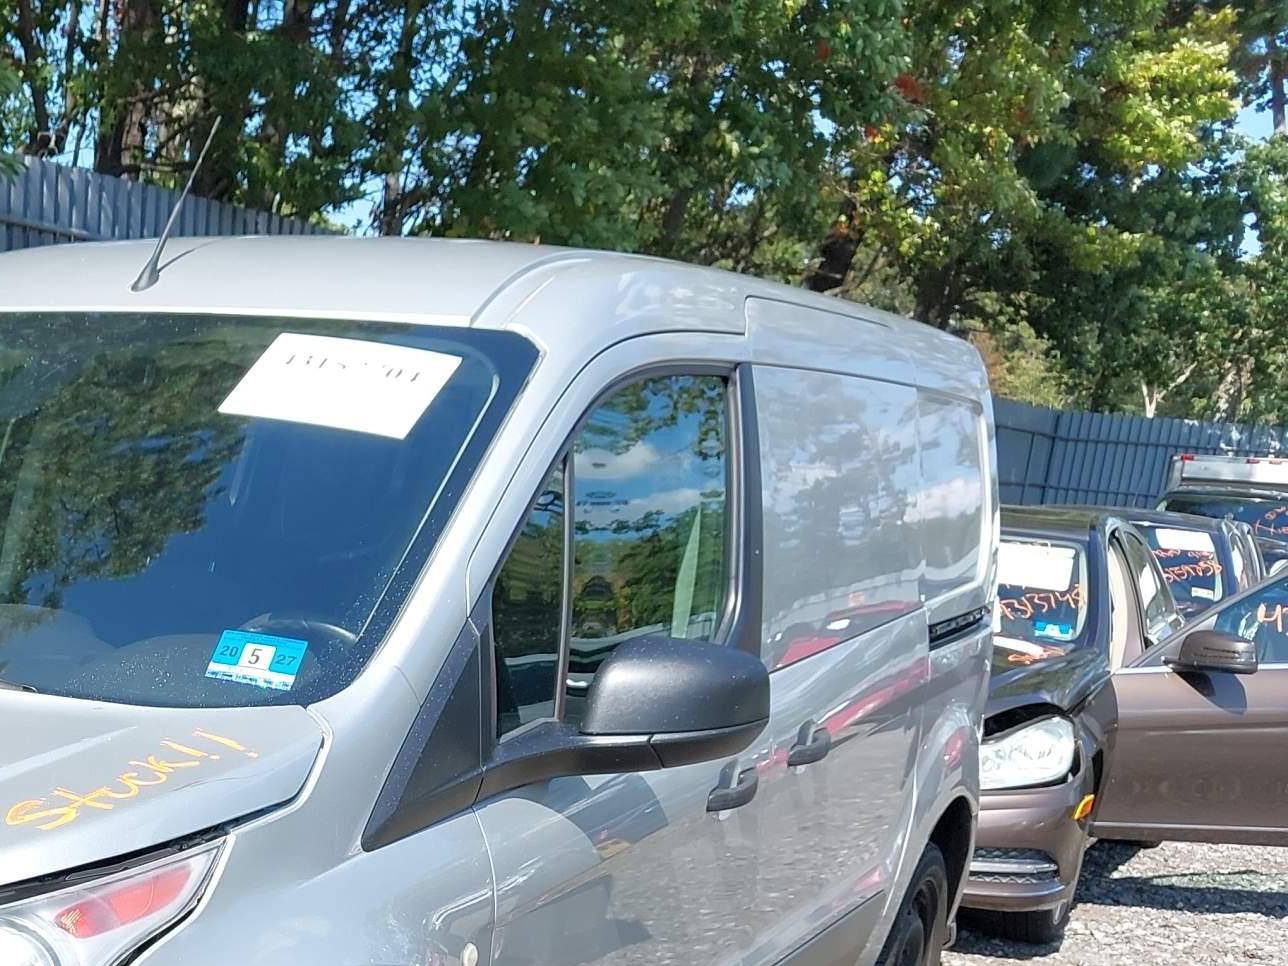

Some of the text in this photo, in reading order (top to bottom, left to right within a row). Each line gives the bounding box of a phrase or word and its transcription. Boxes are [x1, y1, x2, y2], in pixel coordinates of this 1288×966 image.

[219, 645, 297, 666] 20 5 27
